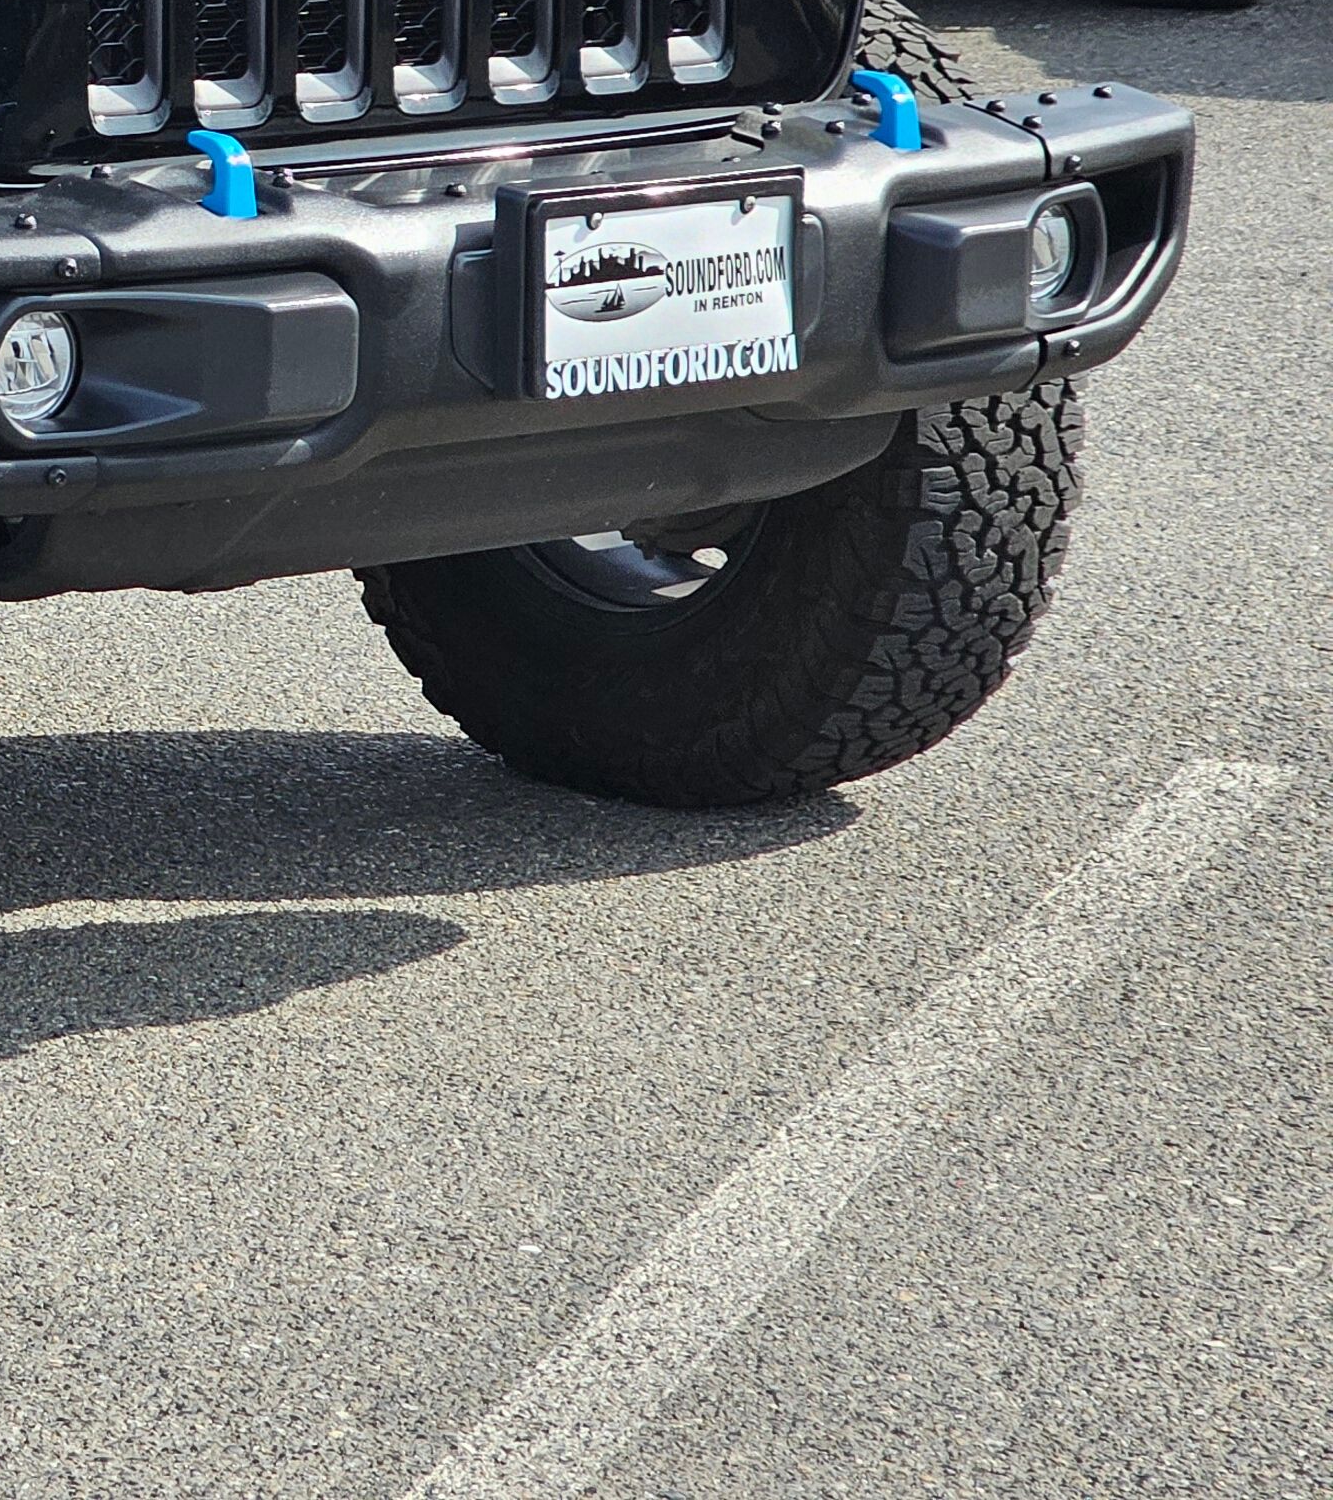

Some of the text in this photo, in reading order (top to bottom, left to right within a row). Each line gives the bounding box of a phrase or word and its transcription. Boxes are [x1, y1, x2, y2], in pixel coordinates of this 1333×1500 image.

[664, 245, 787, 298] SOUNDFORD.COM
[694, 291, 764, 313] IN RENTON
[545, 333, 798, 400] SOUNDFORD.COM
